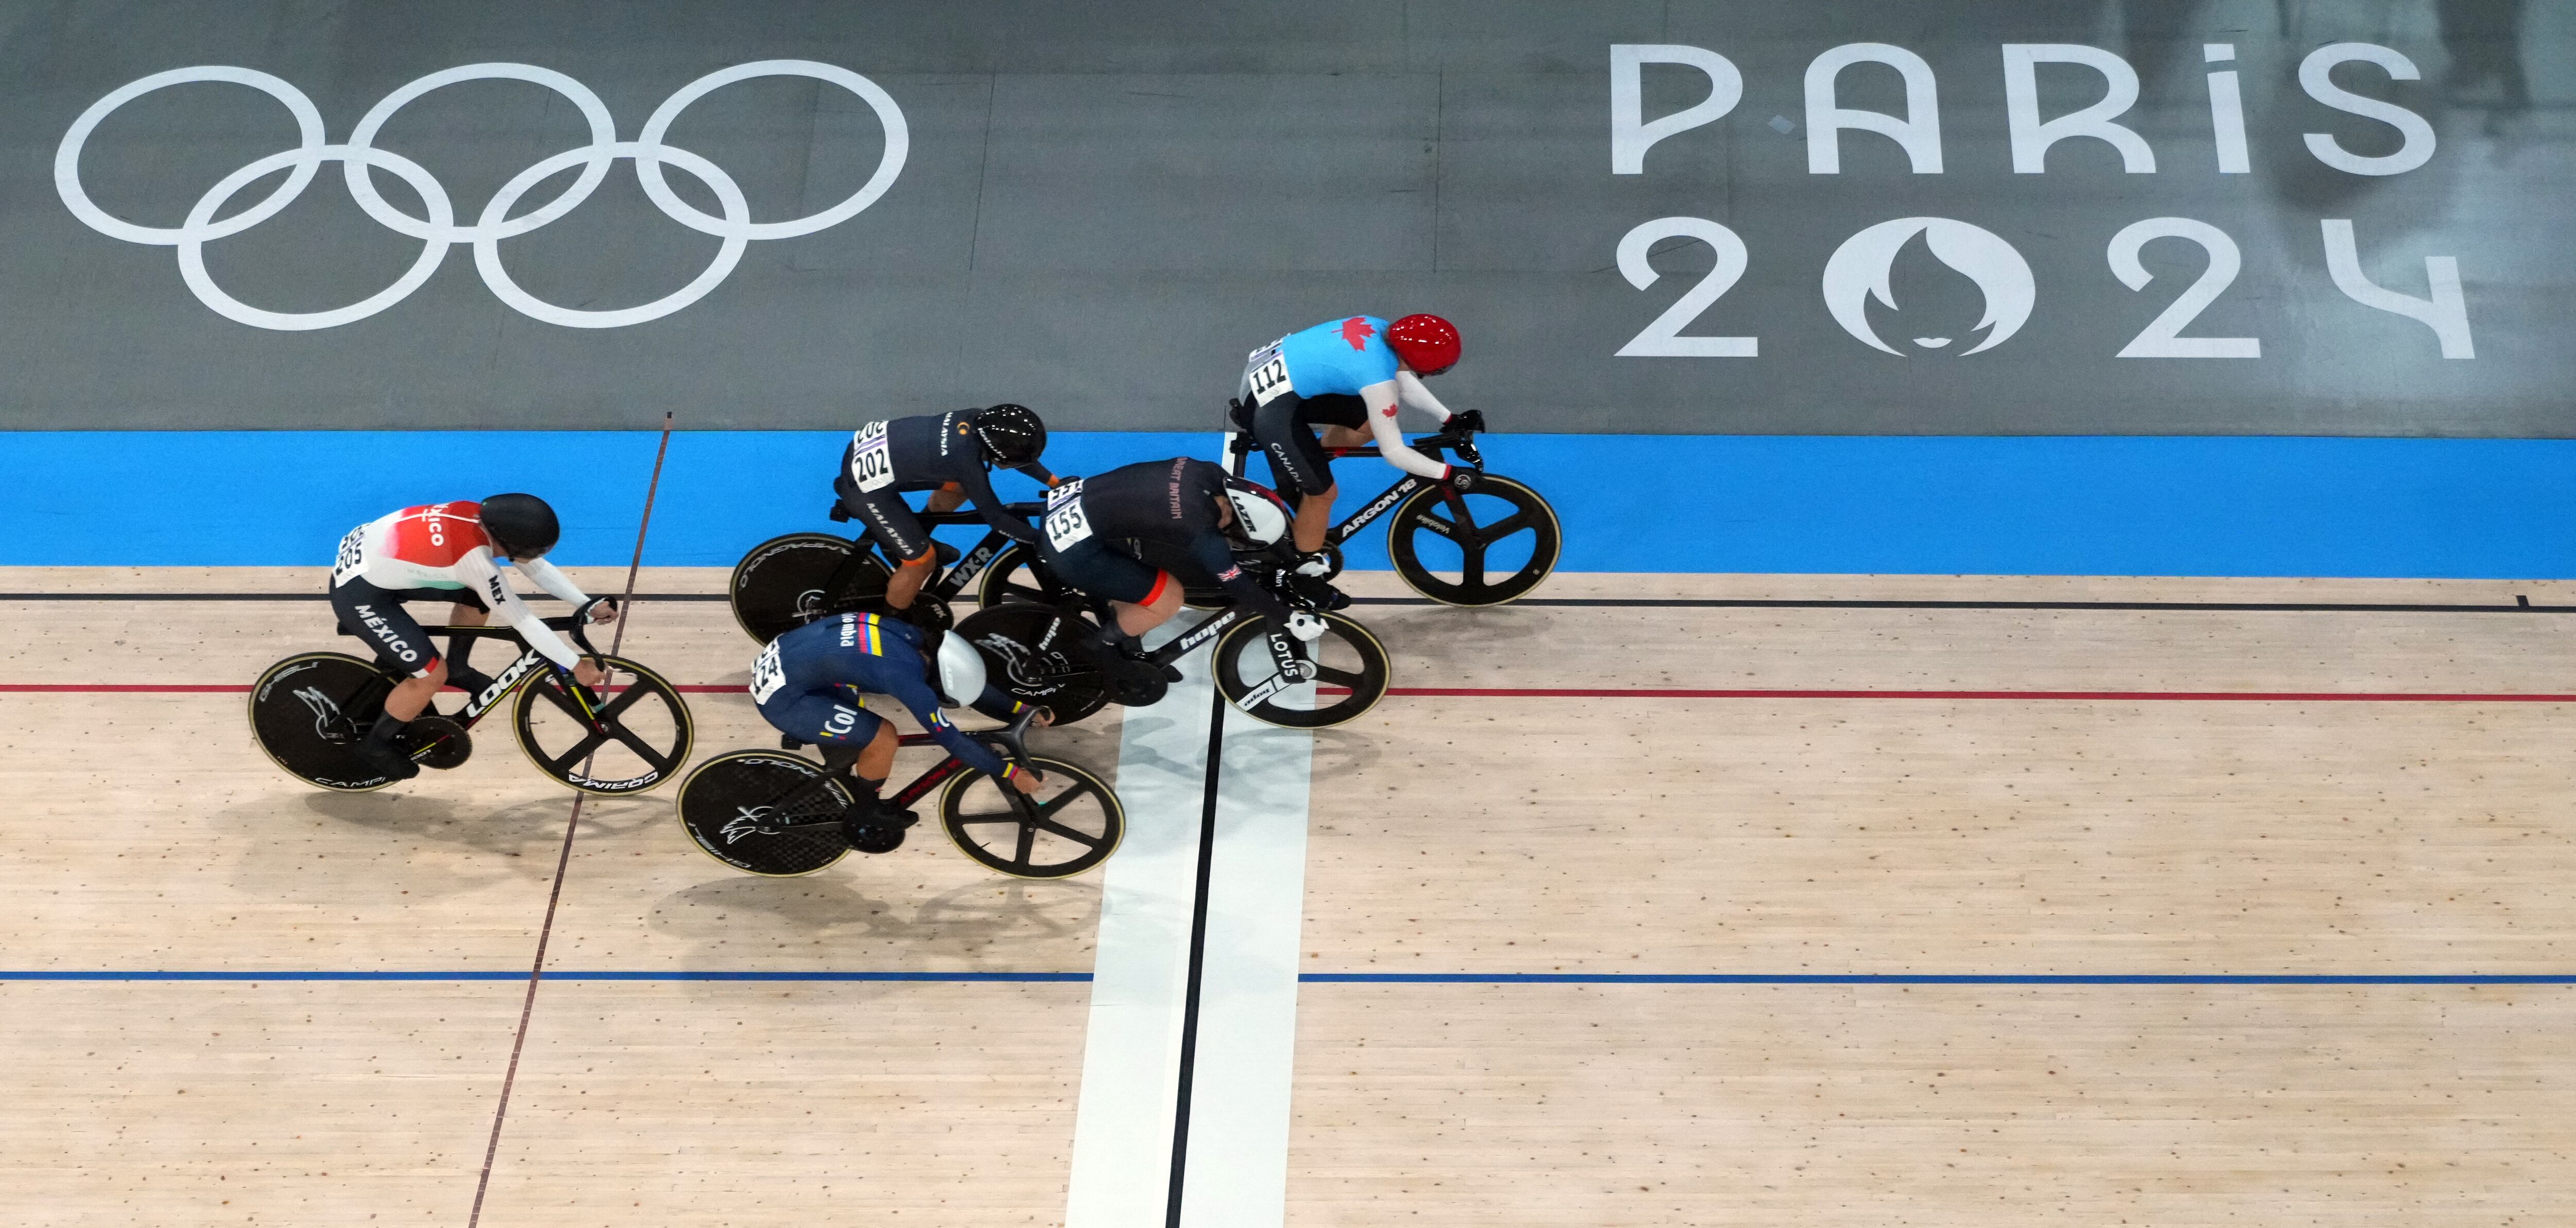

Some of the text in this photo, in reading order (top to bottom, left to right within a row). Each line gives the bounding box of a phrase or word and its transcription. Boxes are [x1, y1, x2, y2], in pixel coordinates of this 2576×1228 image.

[1615, 216, 2475, 359] 2024
[1253, 360, 1286, 394] 112
[855, 448, 888, 483] 202
[1169, 457, 1188, 519] GREAT BRITAIN
[1050, 504, 1082, 541] 155
[1232, 496, 1257, 533] LAZER
[1342, 479, 1417, 537] ARGON 18
[867, 503, 914, 555] MALAYSIA
[335, 541, 362, 575] 205
[949, 547, 994, 586] WX-R
[488, 575, 506, 605] MEX
[354, 605, 418, 662] MÉXICO
[1179, 611, 1236, 655] hope
[1270, 633, 1299, 677] LOTUS
[466, 649, 541, 718] LOOK
[1244, 687, 1271, 713] hope
[824, 704, 858, 734] Col
